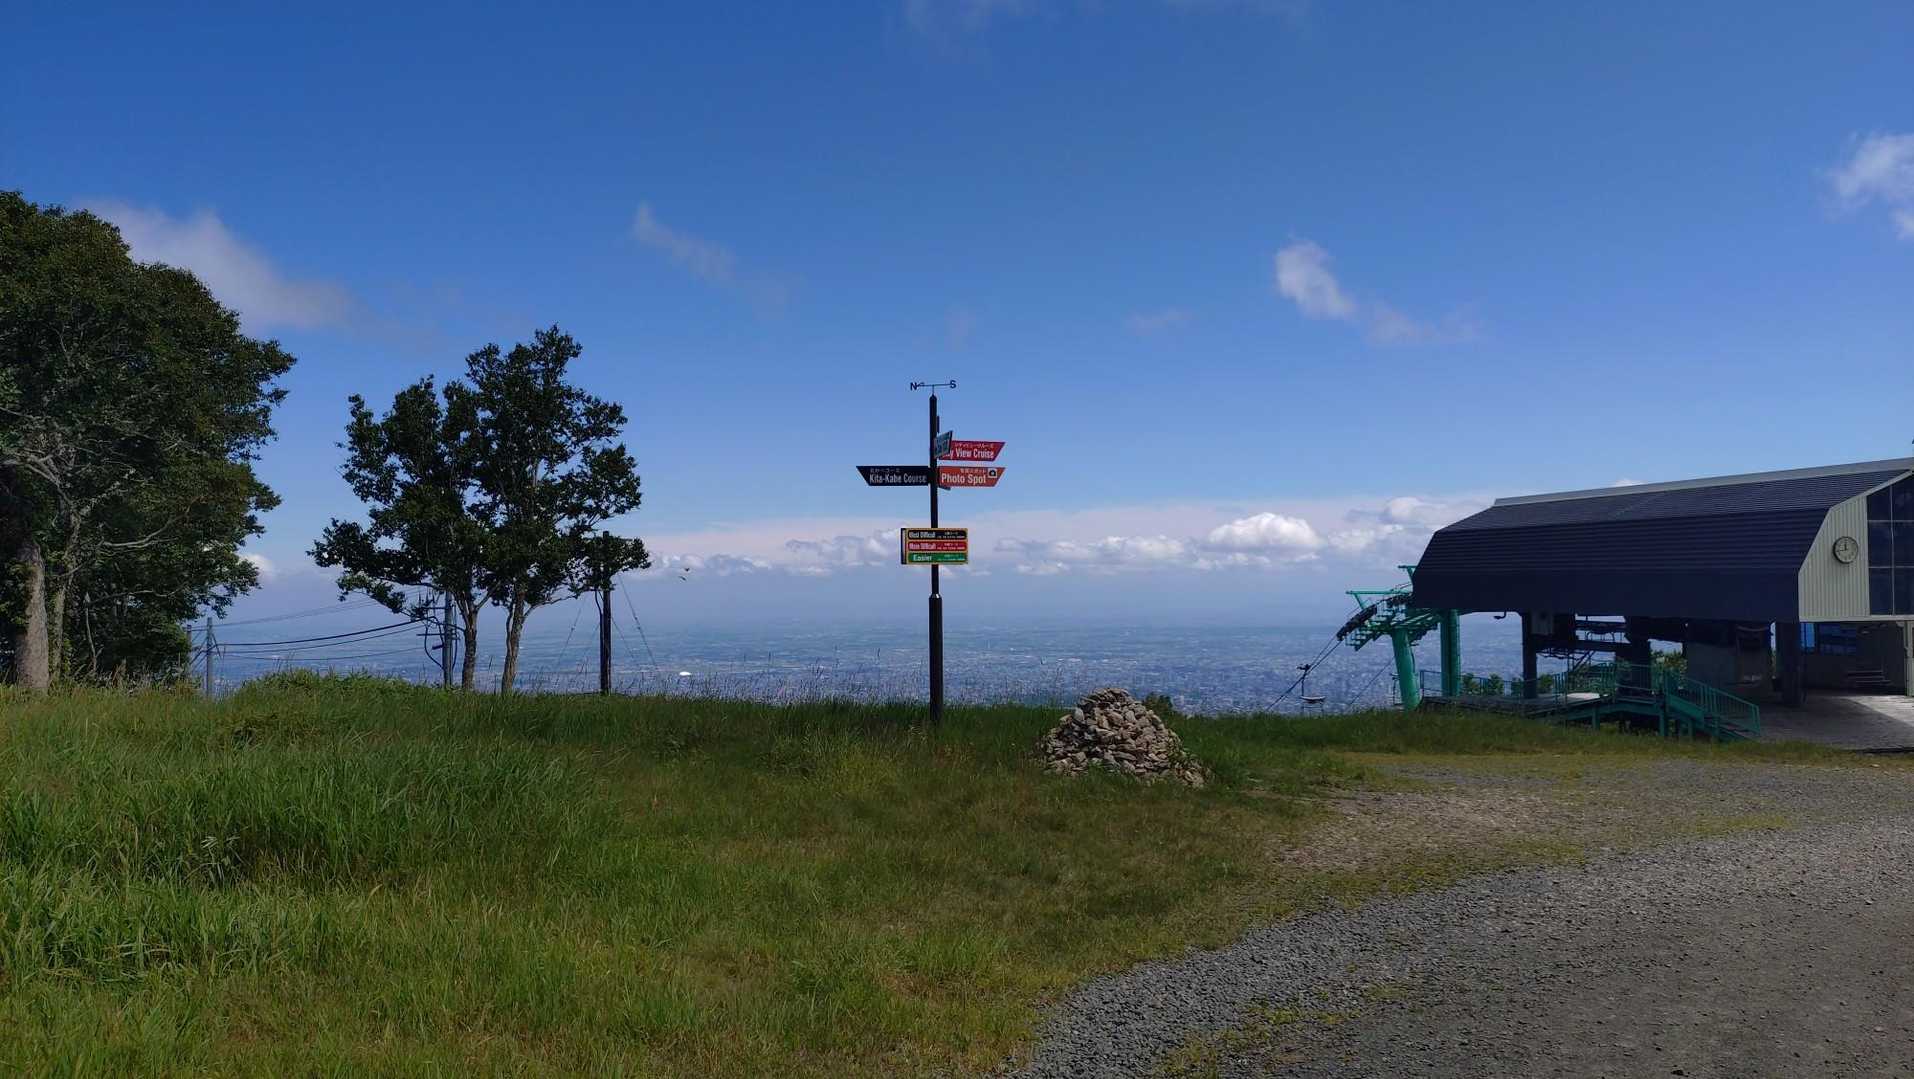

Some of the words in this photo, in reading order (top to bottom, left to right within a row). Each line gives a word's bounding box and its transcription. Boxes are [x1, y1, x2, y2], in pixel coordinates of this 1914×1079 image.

[910, 382, 917, 390] N
[950, 380, 956, 389] S
[955, 447, 972, 457] View
[973, 448, 994, 458] Cruise
[903, 473, 927, 483] Course
[941, 473, 965, 483] Photo
[967, 474, 986, 485] Spot
